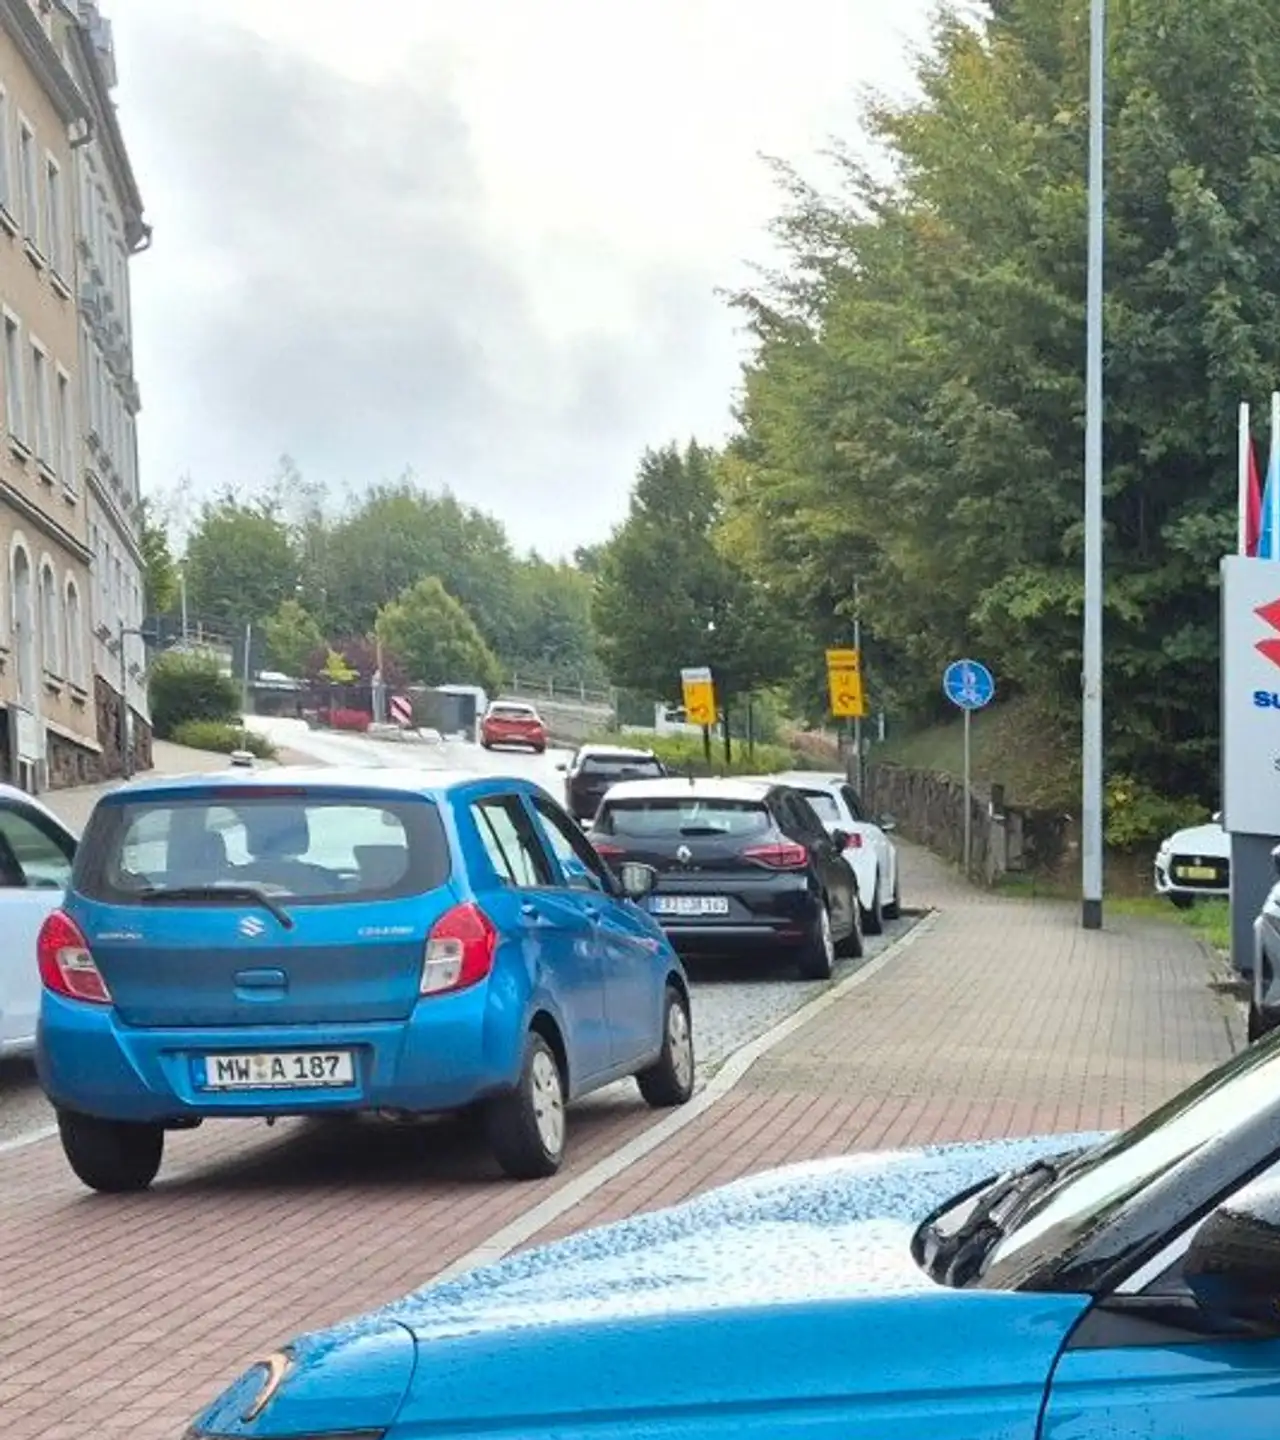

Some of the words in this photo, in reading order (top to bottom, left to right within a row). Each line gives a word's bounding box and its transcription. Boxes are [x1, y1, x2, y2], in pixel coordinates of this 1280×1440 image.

[216, 1058, 250, 1081] MW
[271, 1058, 286, 1080] A
[293, 1055, 340, 1079] 187
